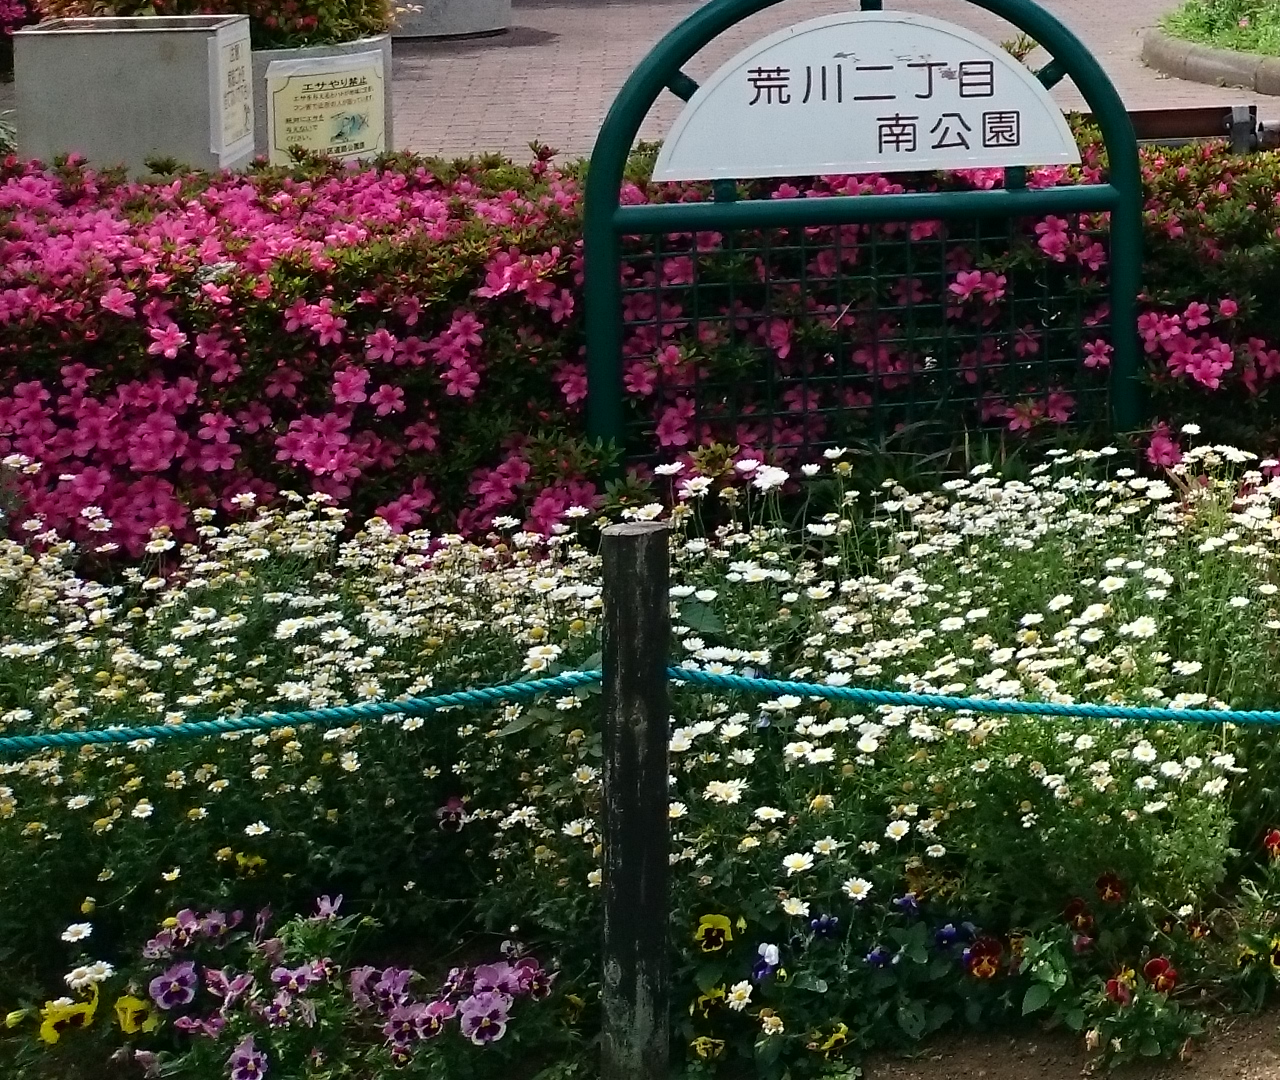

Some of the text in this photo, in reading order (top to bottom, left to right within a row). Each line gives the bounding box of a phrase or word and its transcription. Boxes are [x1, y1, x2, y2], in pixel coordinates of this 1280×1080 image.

[302, 76, 368, 91] エサやり禁止
[747, 60, 995, 106] 荒川二丁目
[875, 110, 1021, 154] 南公園
